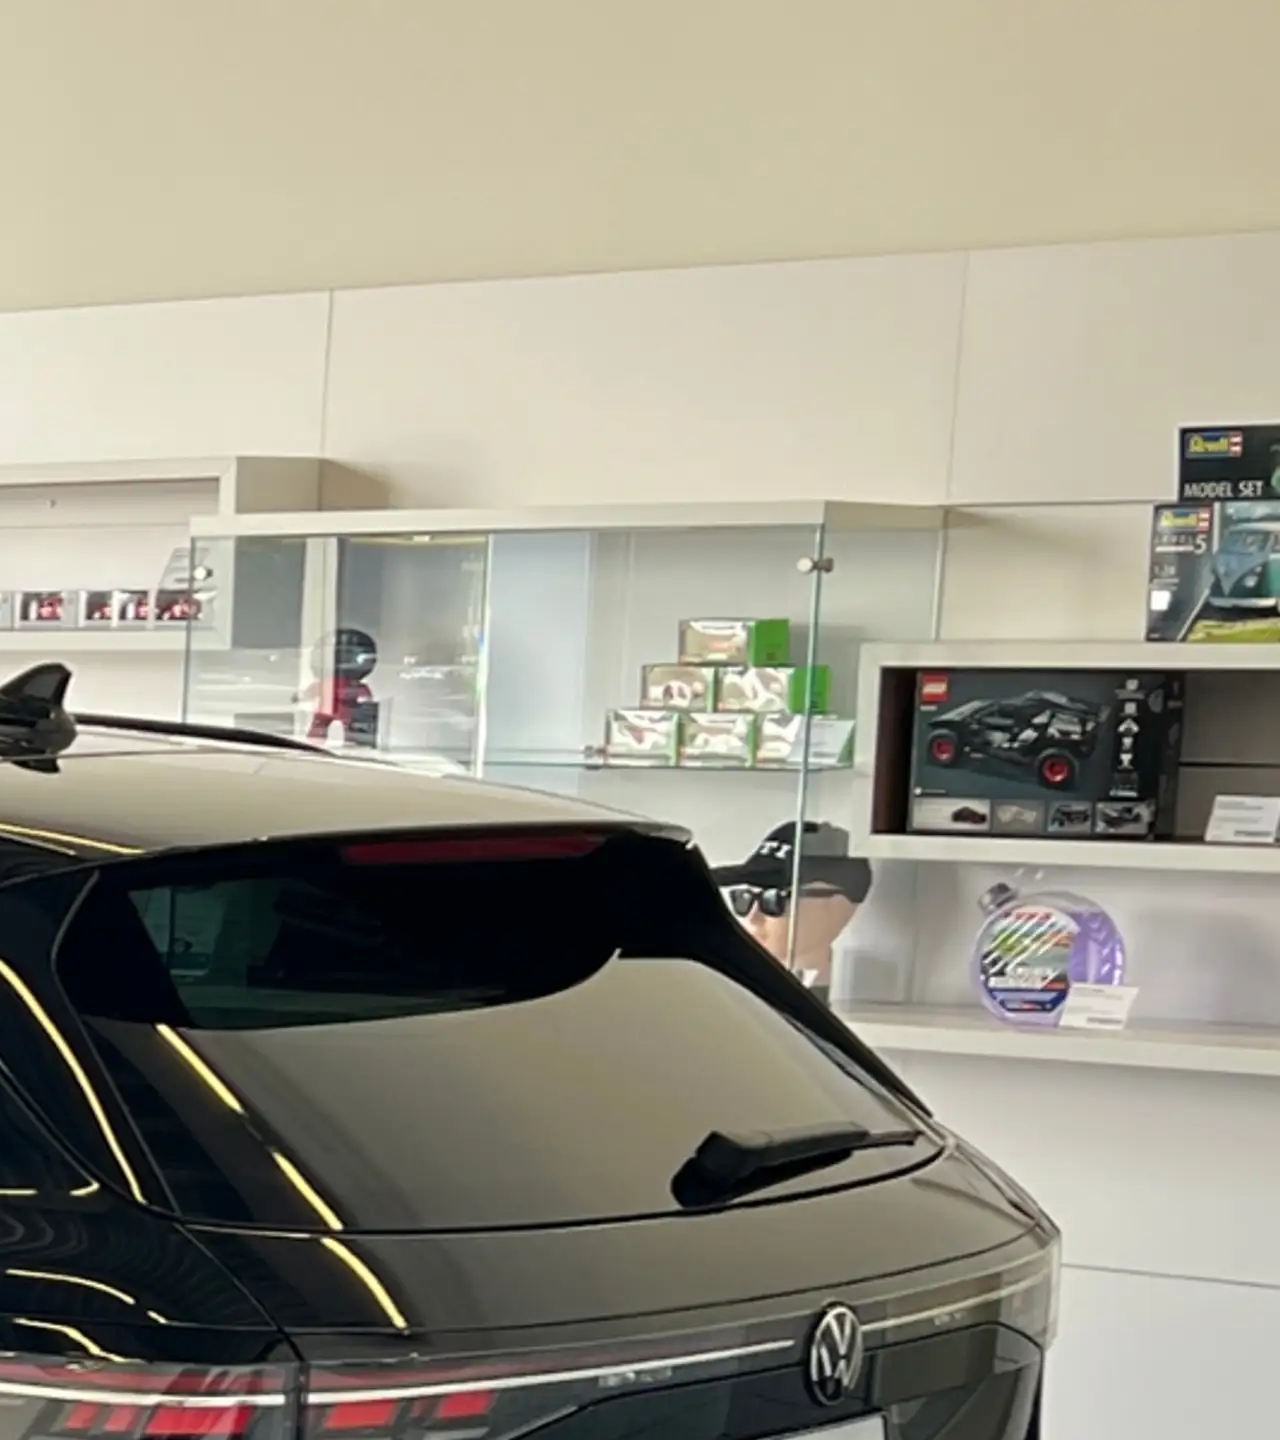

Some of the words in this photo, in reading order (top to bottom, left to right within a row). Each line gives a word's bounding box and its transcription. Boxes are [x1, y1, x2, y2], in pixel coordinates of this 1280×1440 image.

[1184, 482, 1233, 498] MODEL
[1239, 480, 1263, 496] SET
[1193, 534, 1207, 554] 5
